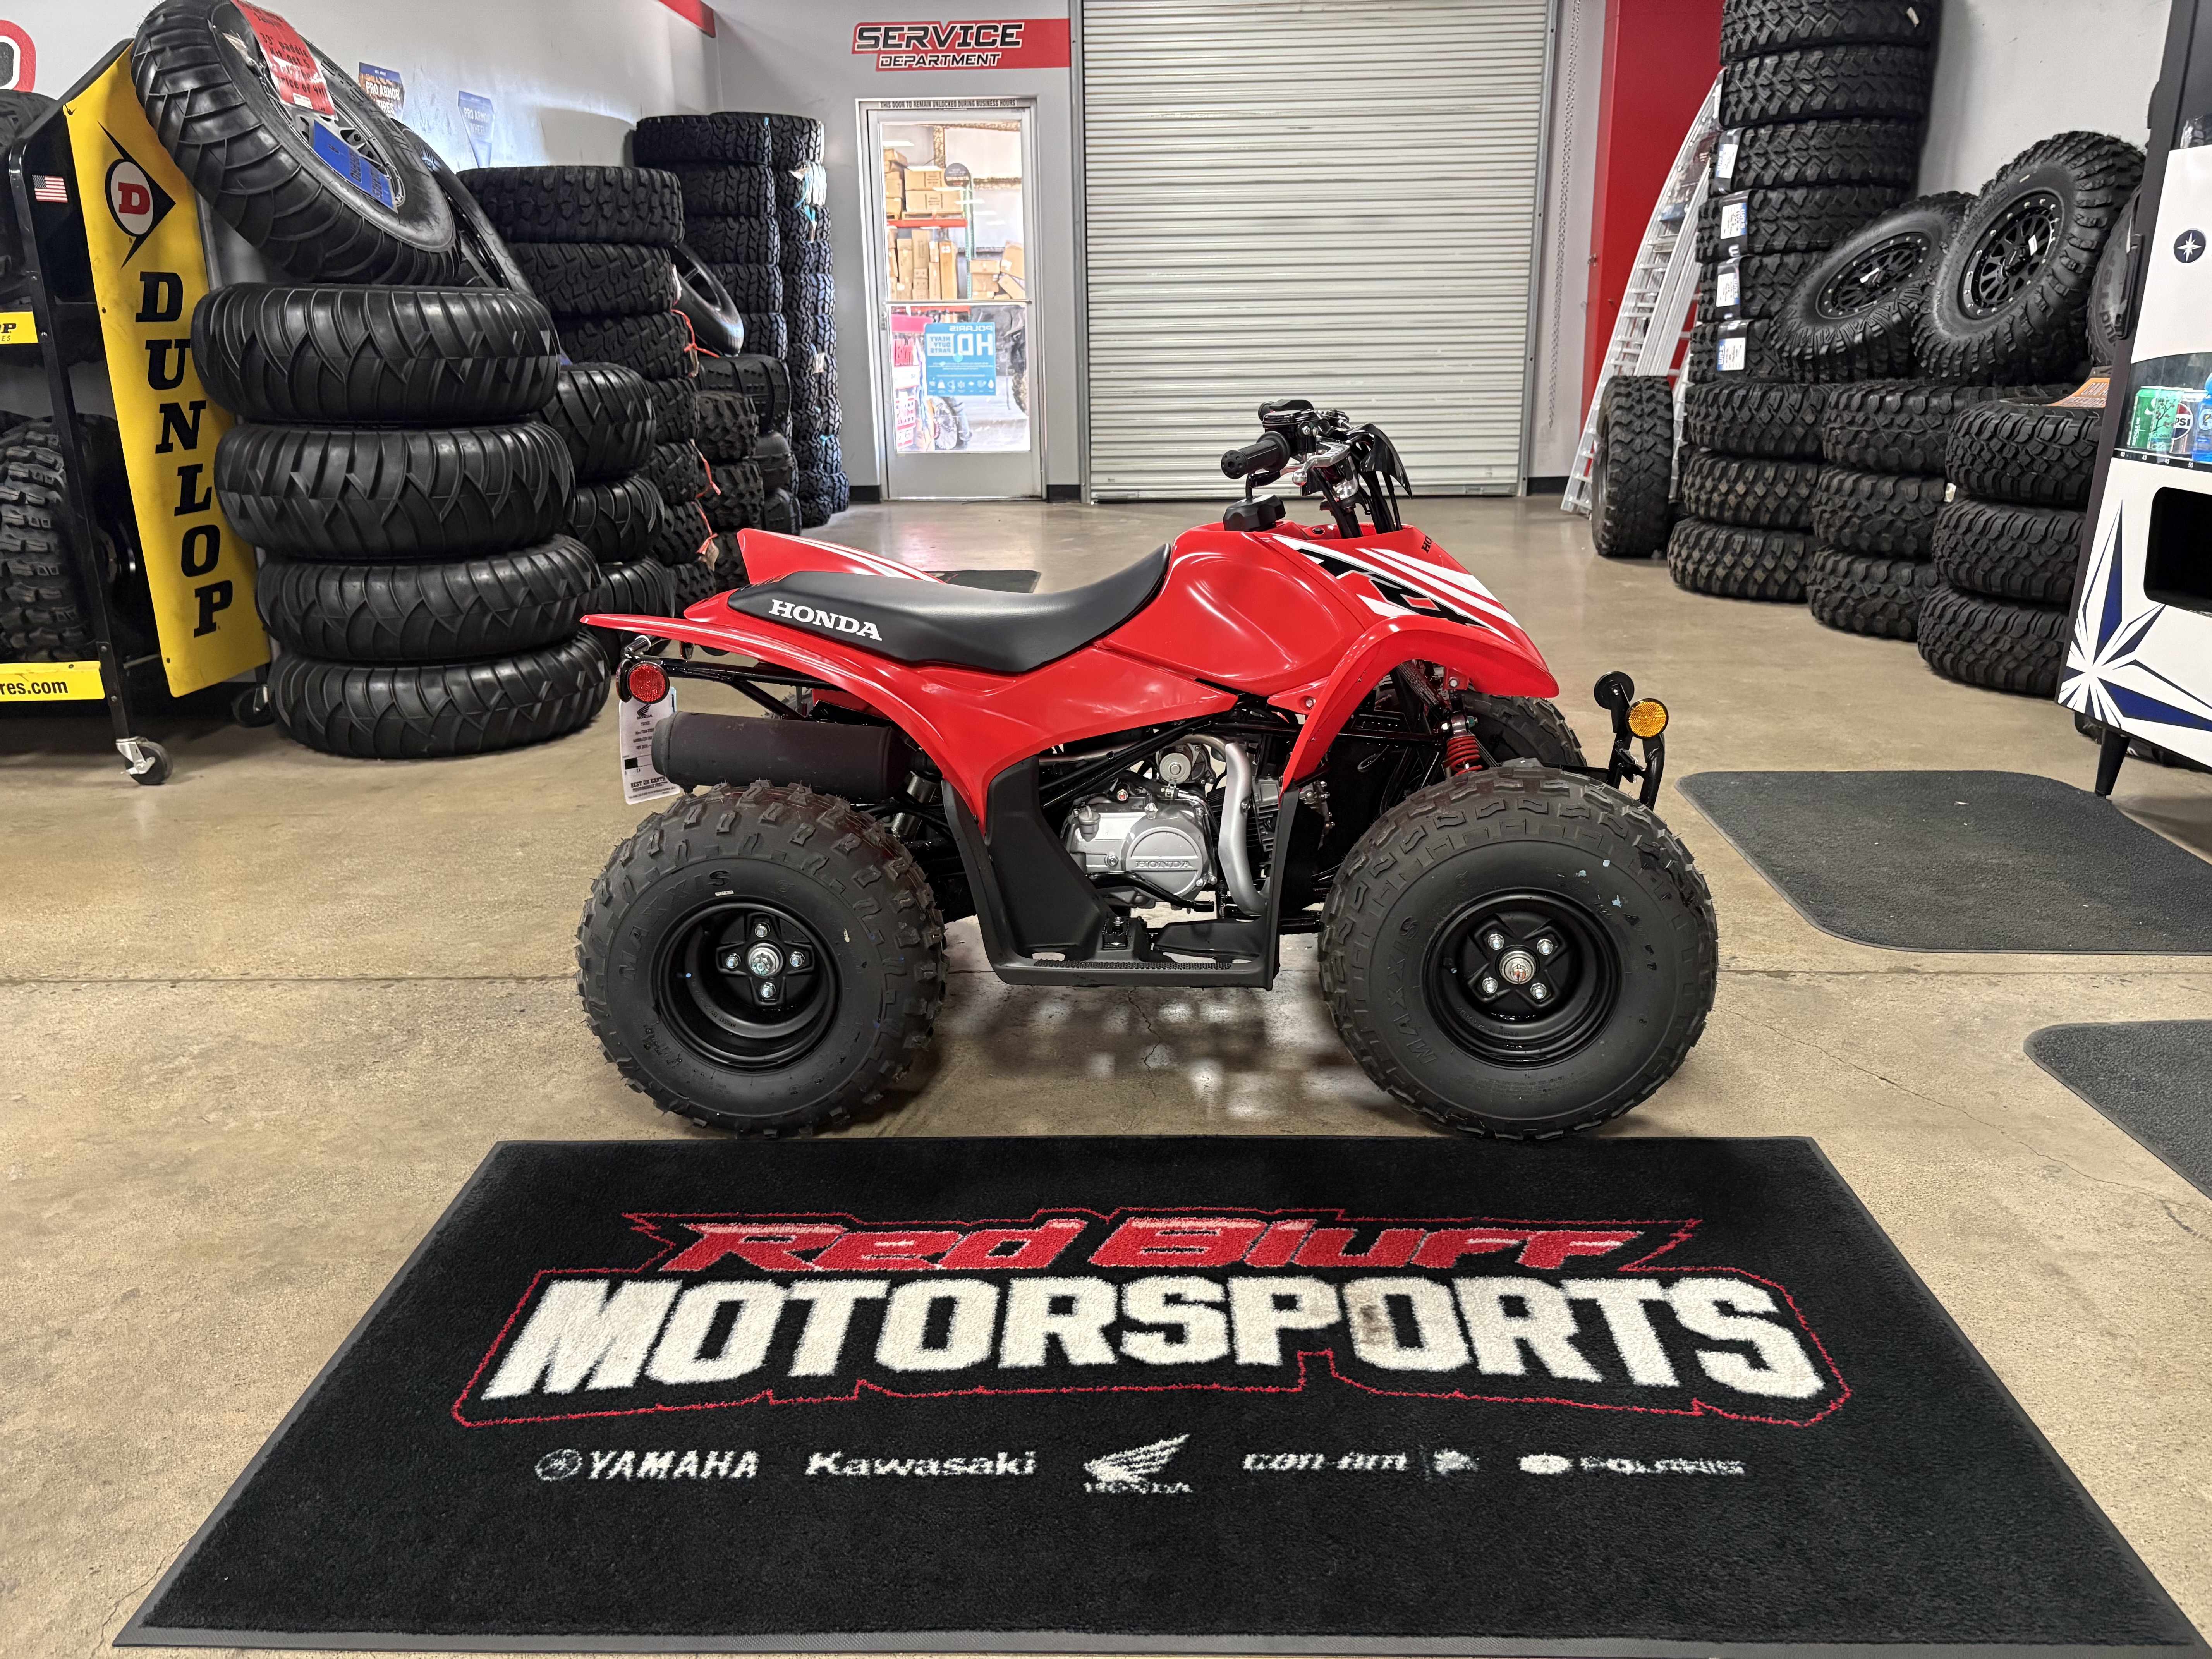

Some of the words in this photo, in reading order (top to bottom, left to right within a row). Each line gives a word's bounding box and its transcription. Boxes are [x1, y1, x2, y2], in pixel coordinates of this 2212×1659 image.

[278, 41, 309, 58] paddle
[855, 23, 1024, 51] SERVICE
[879, 52, 1002, 68] DEPARTMENT
[365, 81, 378, 95] PRO
[380, 84, 400, 101] ARMOR
[376, 99, 395, 115] TIRES
[135, 271, 233, 637] DUNLOP
[768, 599, 883, 641] HONDA
[1135, 860, 1194, 869] HONDA
[619, 870, 731, 981] MAXXIS
[1387, 915, 1437, 1064] MAXXIS
[658, 1219, 1089, 1272] Red
[481, 1275, 1825, 1400] MOTORSPORTS
[588, 1449, 759, 1480] YAMAHA
[805, 1451, 1037, 1477] Kawasaki
